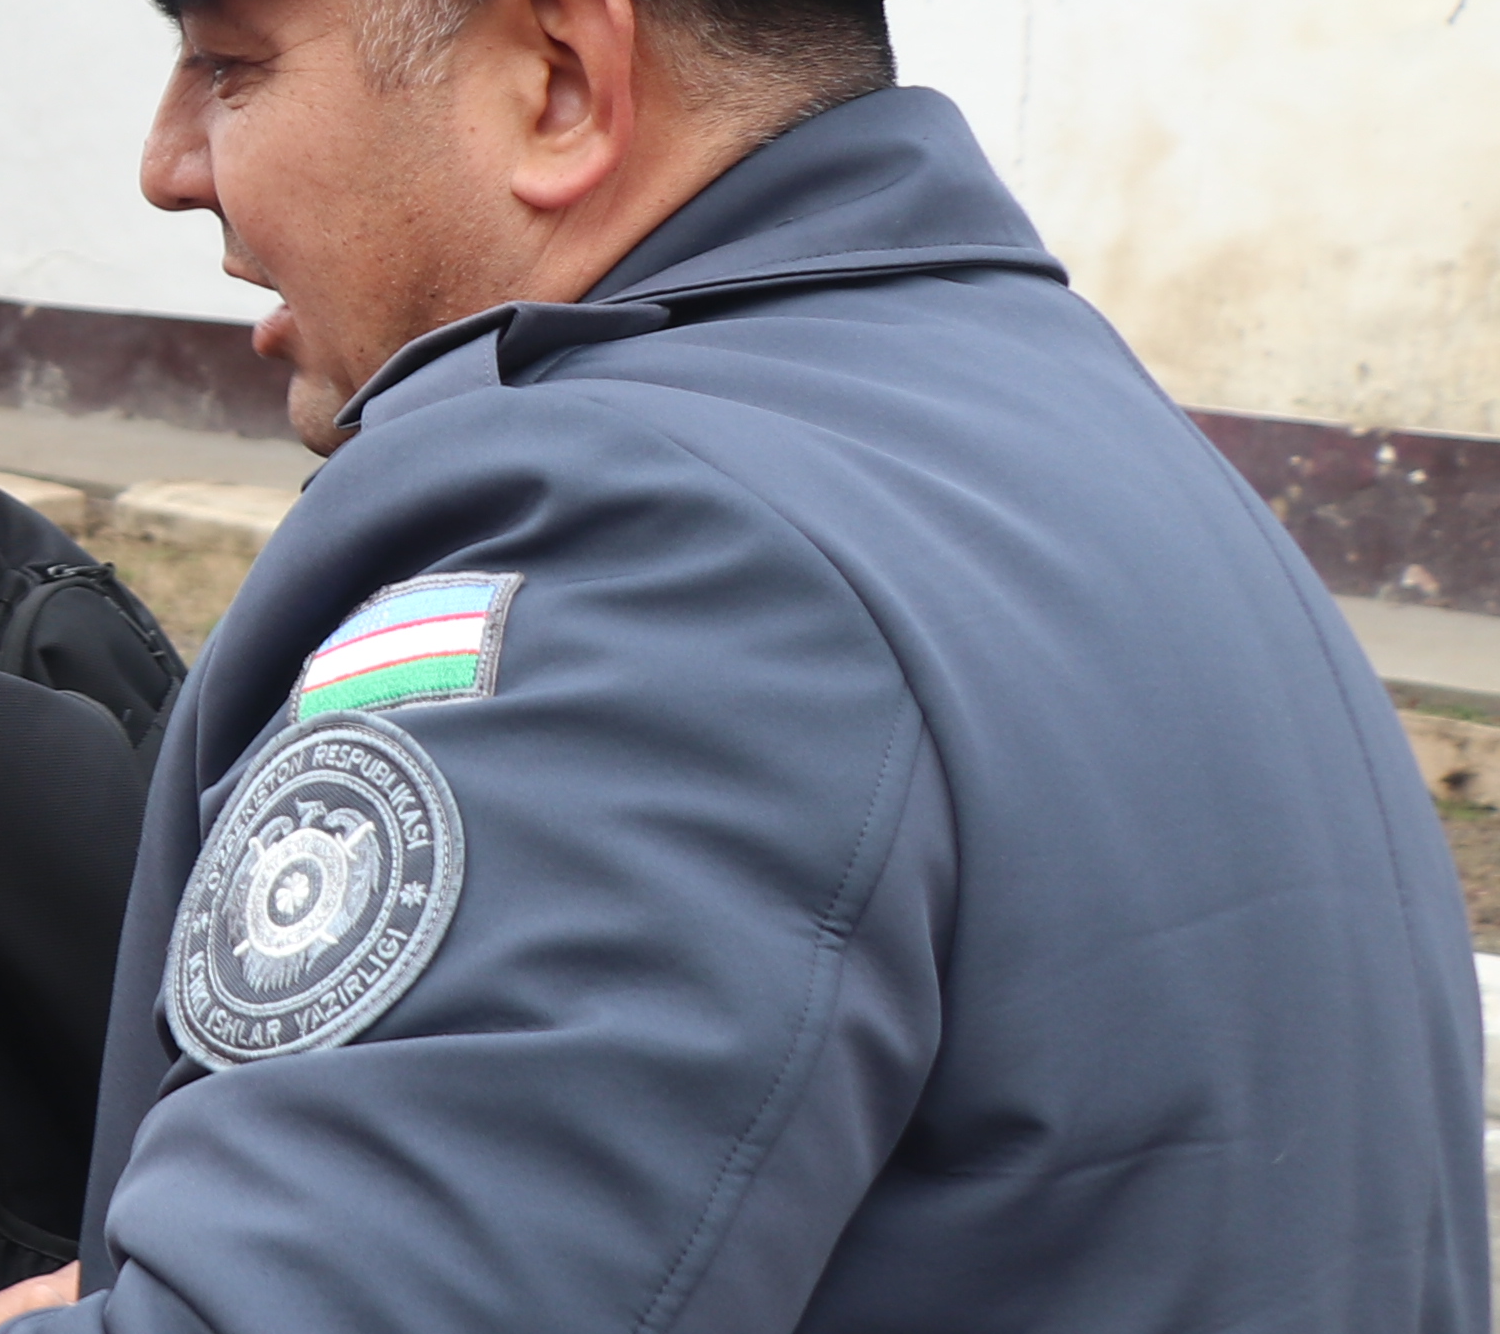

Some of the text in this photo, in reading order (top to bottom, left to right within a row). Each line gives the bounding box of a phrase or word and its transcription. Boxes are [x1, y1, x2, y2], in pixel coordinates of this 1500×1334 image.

[312, 744, 431, 850] RESPUBLIKASI
[205, 1005, 281, 1047] ISHLAR
[294, 928, 411, 1036] VAZIRLIGI
